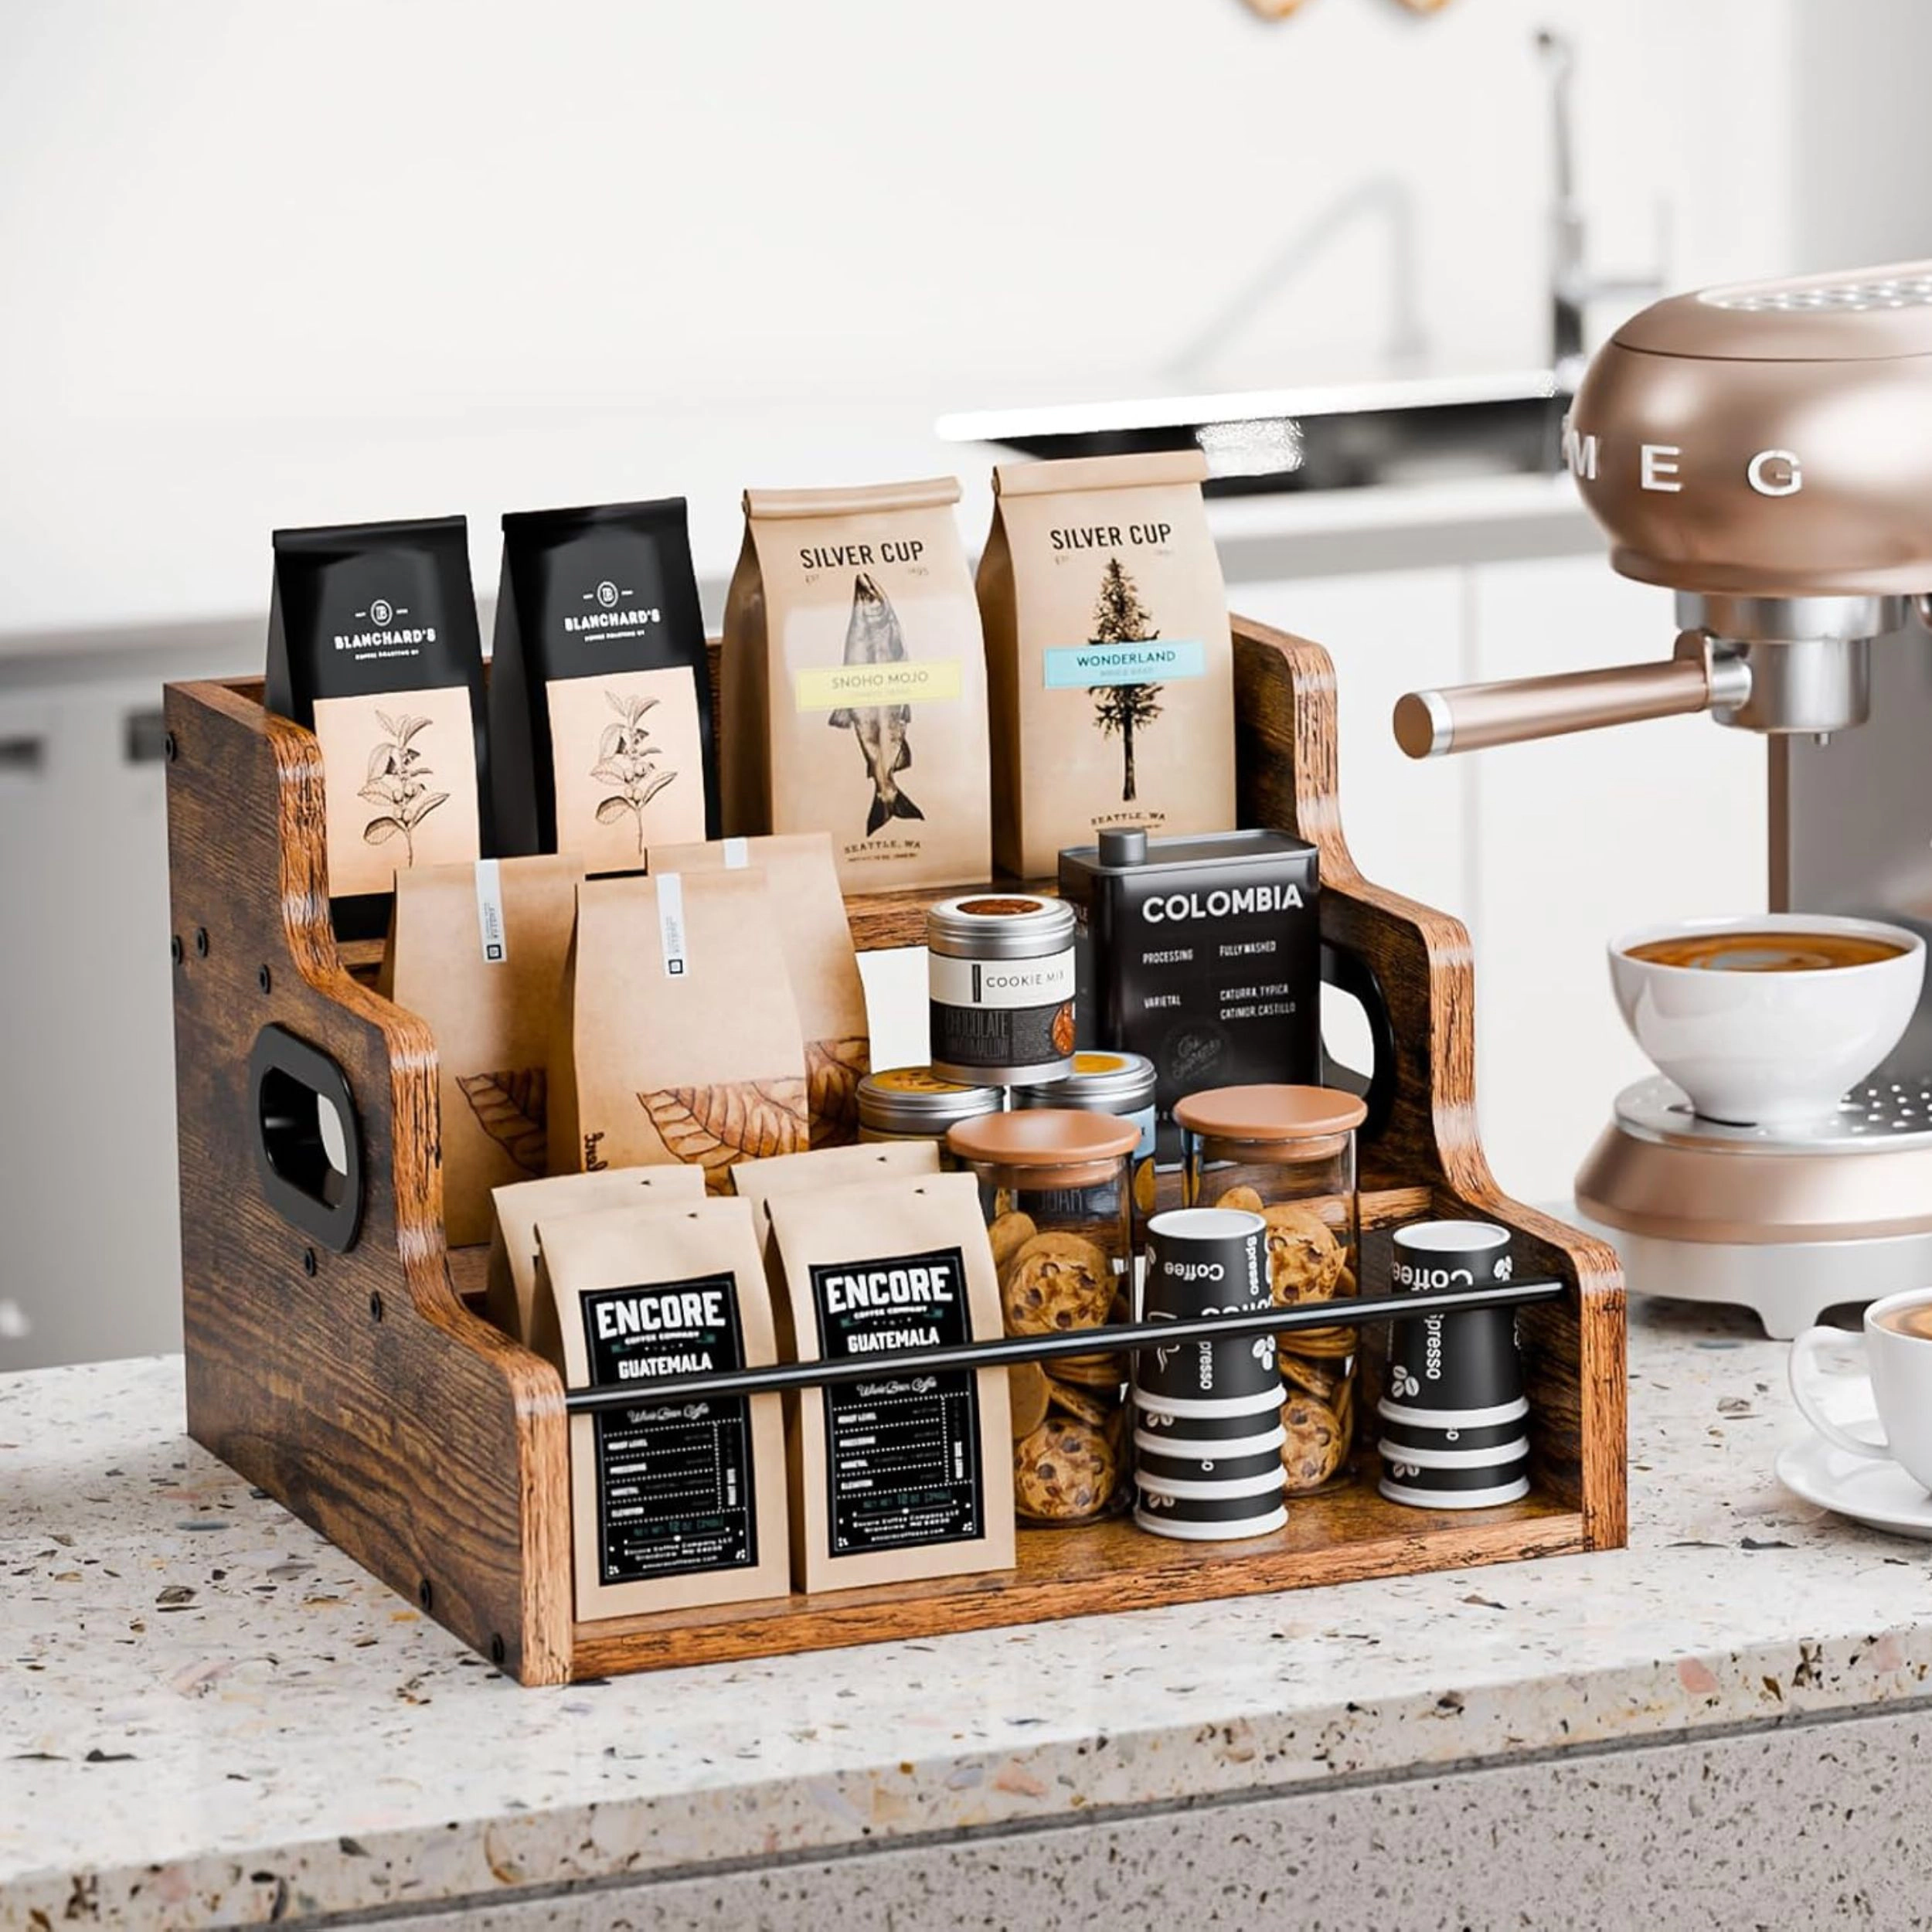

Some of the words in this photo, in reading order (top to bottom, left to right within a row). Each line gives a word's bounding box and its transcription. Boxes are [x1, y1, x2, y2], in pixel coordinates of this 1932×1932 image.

[1049, 526, 1123, 550] SILVER
[1129, 523, 1172, 545] CUP
[800, 545, 875, 569] SILVER
[880, 540, 923, 563] CUP
[564, 608, 661, 632] BLANCHARD'S
[334, 628, 436, 650] BLANCHARD'S
[1077, 651, 1176, 666] WONDERLAND
[832, 675, 883, 689] SNOHO
[888, 670, 929, 683] MOJO
[904, 840, 921, 849] WA
[1142, 883, 1304, 923] COLOMBIA
[1142, 948, 1194, 964] PROCESSING
[1219, 944, 1243, 957] FULLY
[1243, 940, 1277, 954] WASHED
[986, 974, 1042, 988] COOKIE
[1260, 983, 1289, 997] TYPICA
[1144, 995, 1181, 1009] VARIETAL
[1257, 1002, 1296, 1016] CASTILLO
[1164, 1261, 1225, 1281] Coffee
[825, 1267, 953, 1315] ENCORE
[596, 1291, 726, 1340] ENCORE
[847, 1326, 940, 1352] GUATEMALA
[618, 1352, 713, 1380] GUATEMALA
